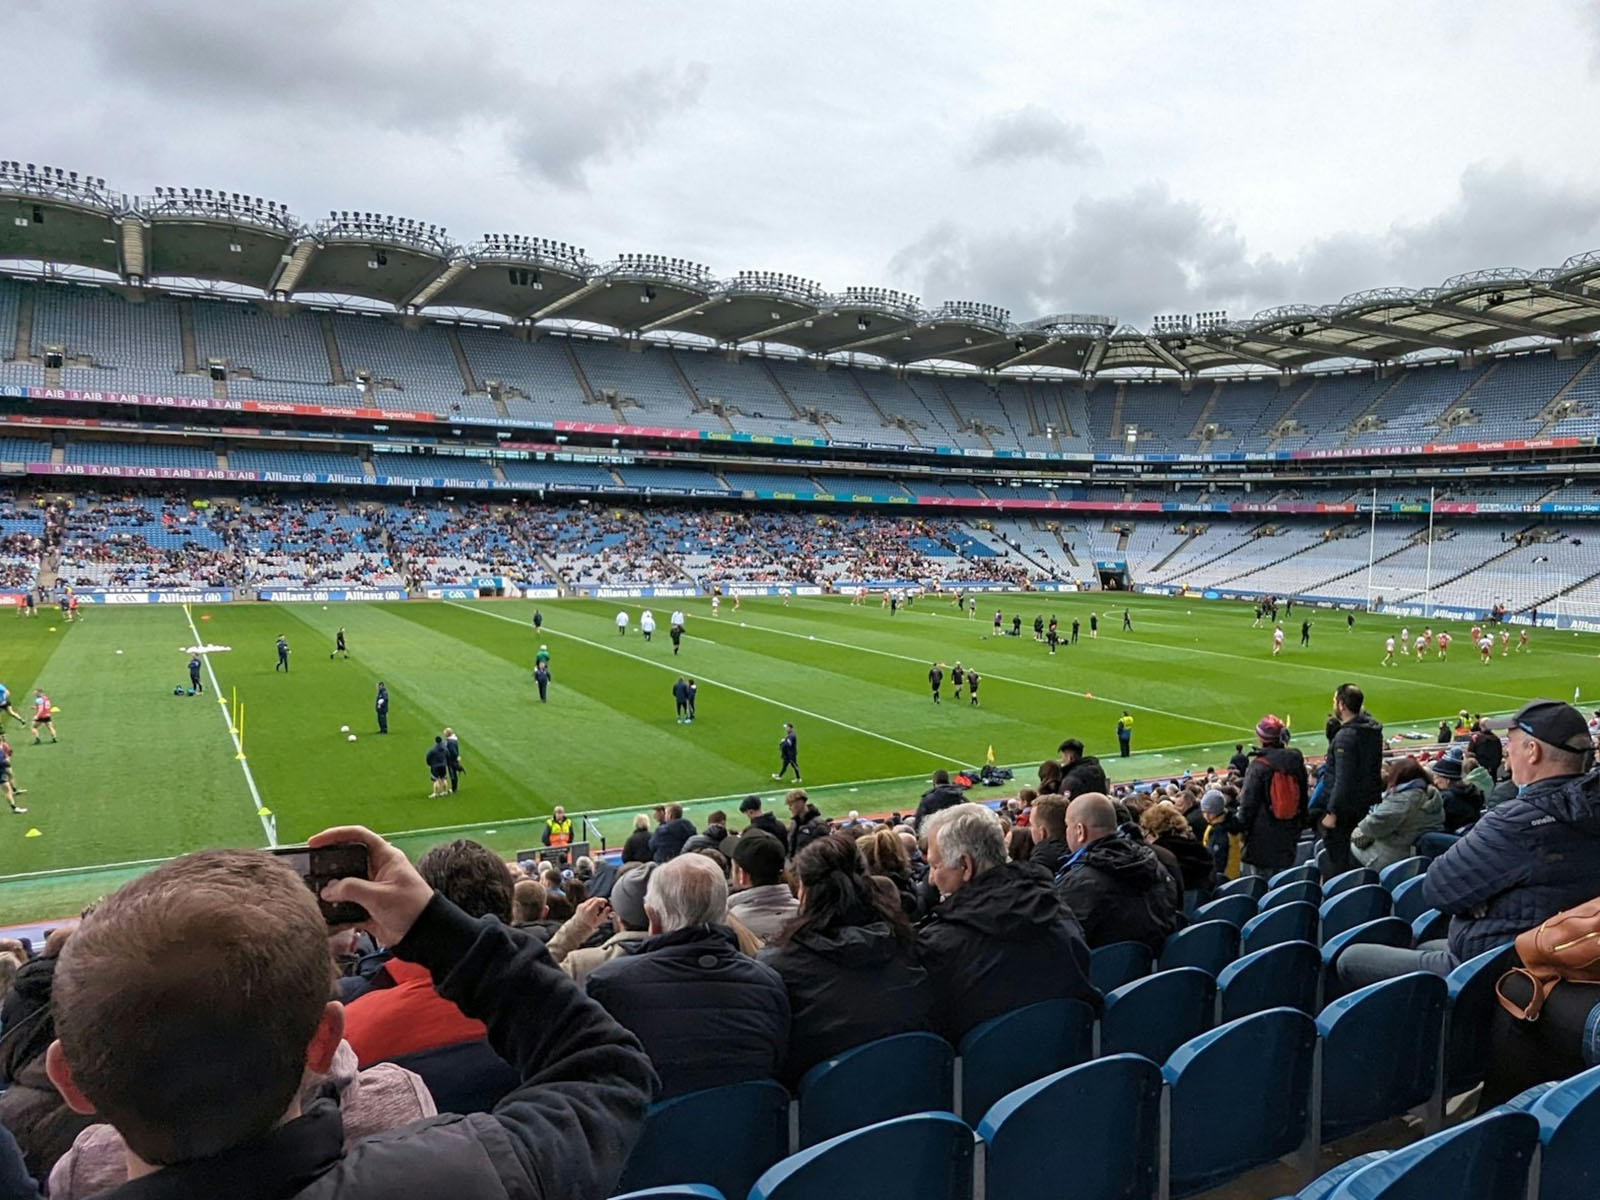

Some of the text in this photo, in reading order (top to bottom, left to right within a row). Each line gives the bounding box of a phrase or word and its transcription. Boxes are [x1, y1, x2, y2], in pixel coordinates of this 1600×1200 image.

[44, 390, 65, 399] AIB
[83, 392, 102, 400] AIB
[119, 394, 139, 403] AIB
[155, 396, 174, 405] AIB
[190, 399, 208, 407] AIB
[224, 401, 242, 409] AIB
[257, 403, 294, 412] SuperValu
[321, 406, 357, 416] SuperValu
[381, 411, 416, 420] SuperValu
[64, 465, 84, 474] AIB
[101, 467, 121, 475] AIB
[138, 468, 156, 477] AIB
[172, 469, 191, 477] AIB
[207, 470, 225, 479] AIB
[238, 471, 255, 480] AIB
[264, 472, 301, 481] Allianz
[327, 474, 362, 484] Allianz
[386, 476, 419, 486] Allianz
[443, 478, 475, 488] Allianz
[1400, 503, 1422, 511] Centra
[478, 578, 496, 587] GAA
[158, 592, 203, 602] Allianz
[271, 591, 311, 601] Allianz
[345, 591, 384, 600] Allianz
[448, 590, 466, 599] GAA
[597, 588, 628, 597] Allianz
[653, 588, 684, 597] Allianz
[1382, 605, 1410, 615] Allianz
[1433, 609, 1463, 620] Allianz
